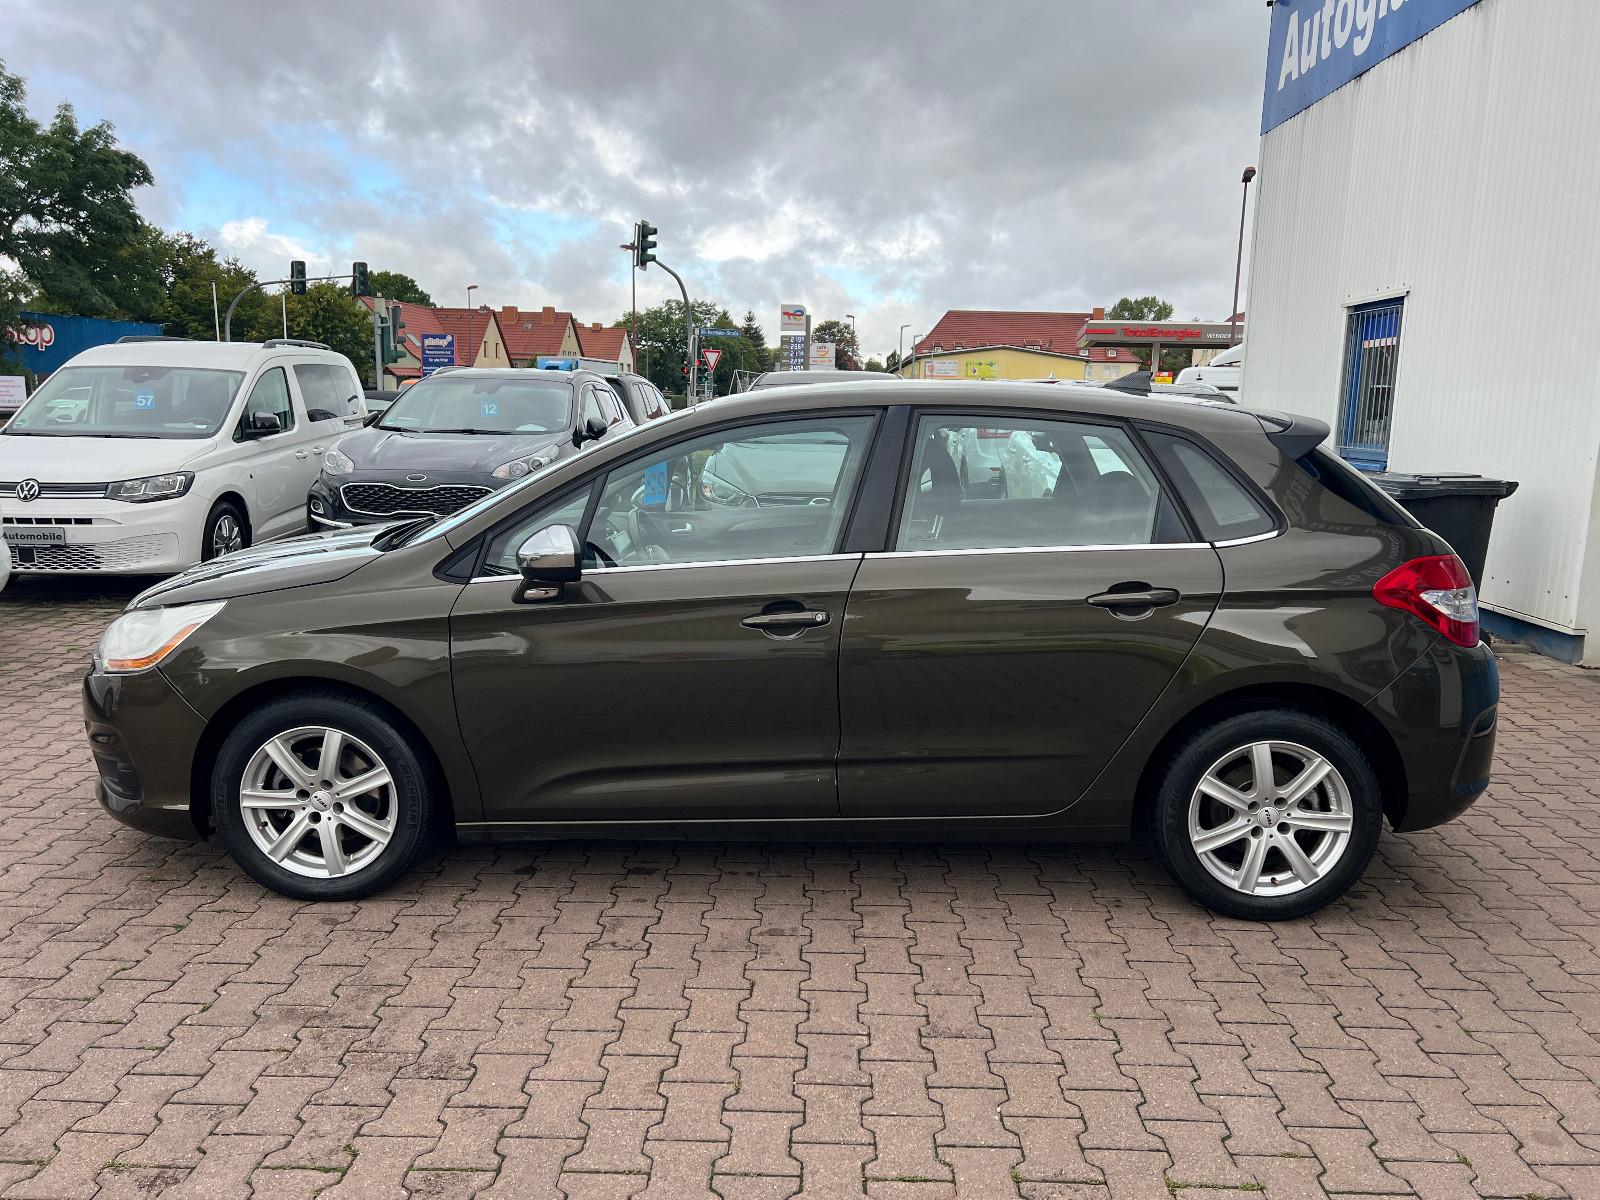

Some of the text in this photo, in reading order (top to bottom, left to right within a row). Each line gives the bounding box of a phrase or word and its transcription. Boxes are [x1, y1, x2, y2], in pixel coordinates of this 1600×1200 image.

[1278, 0, 1409, 91] Autog
[1121, 327, 1201, 341] TotalEnergies
[136, 395, 155, 406] 57
[482, 403, 497, 414] 12
[3, 531, 62, 540] Automobile
